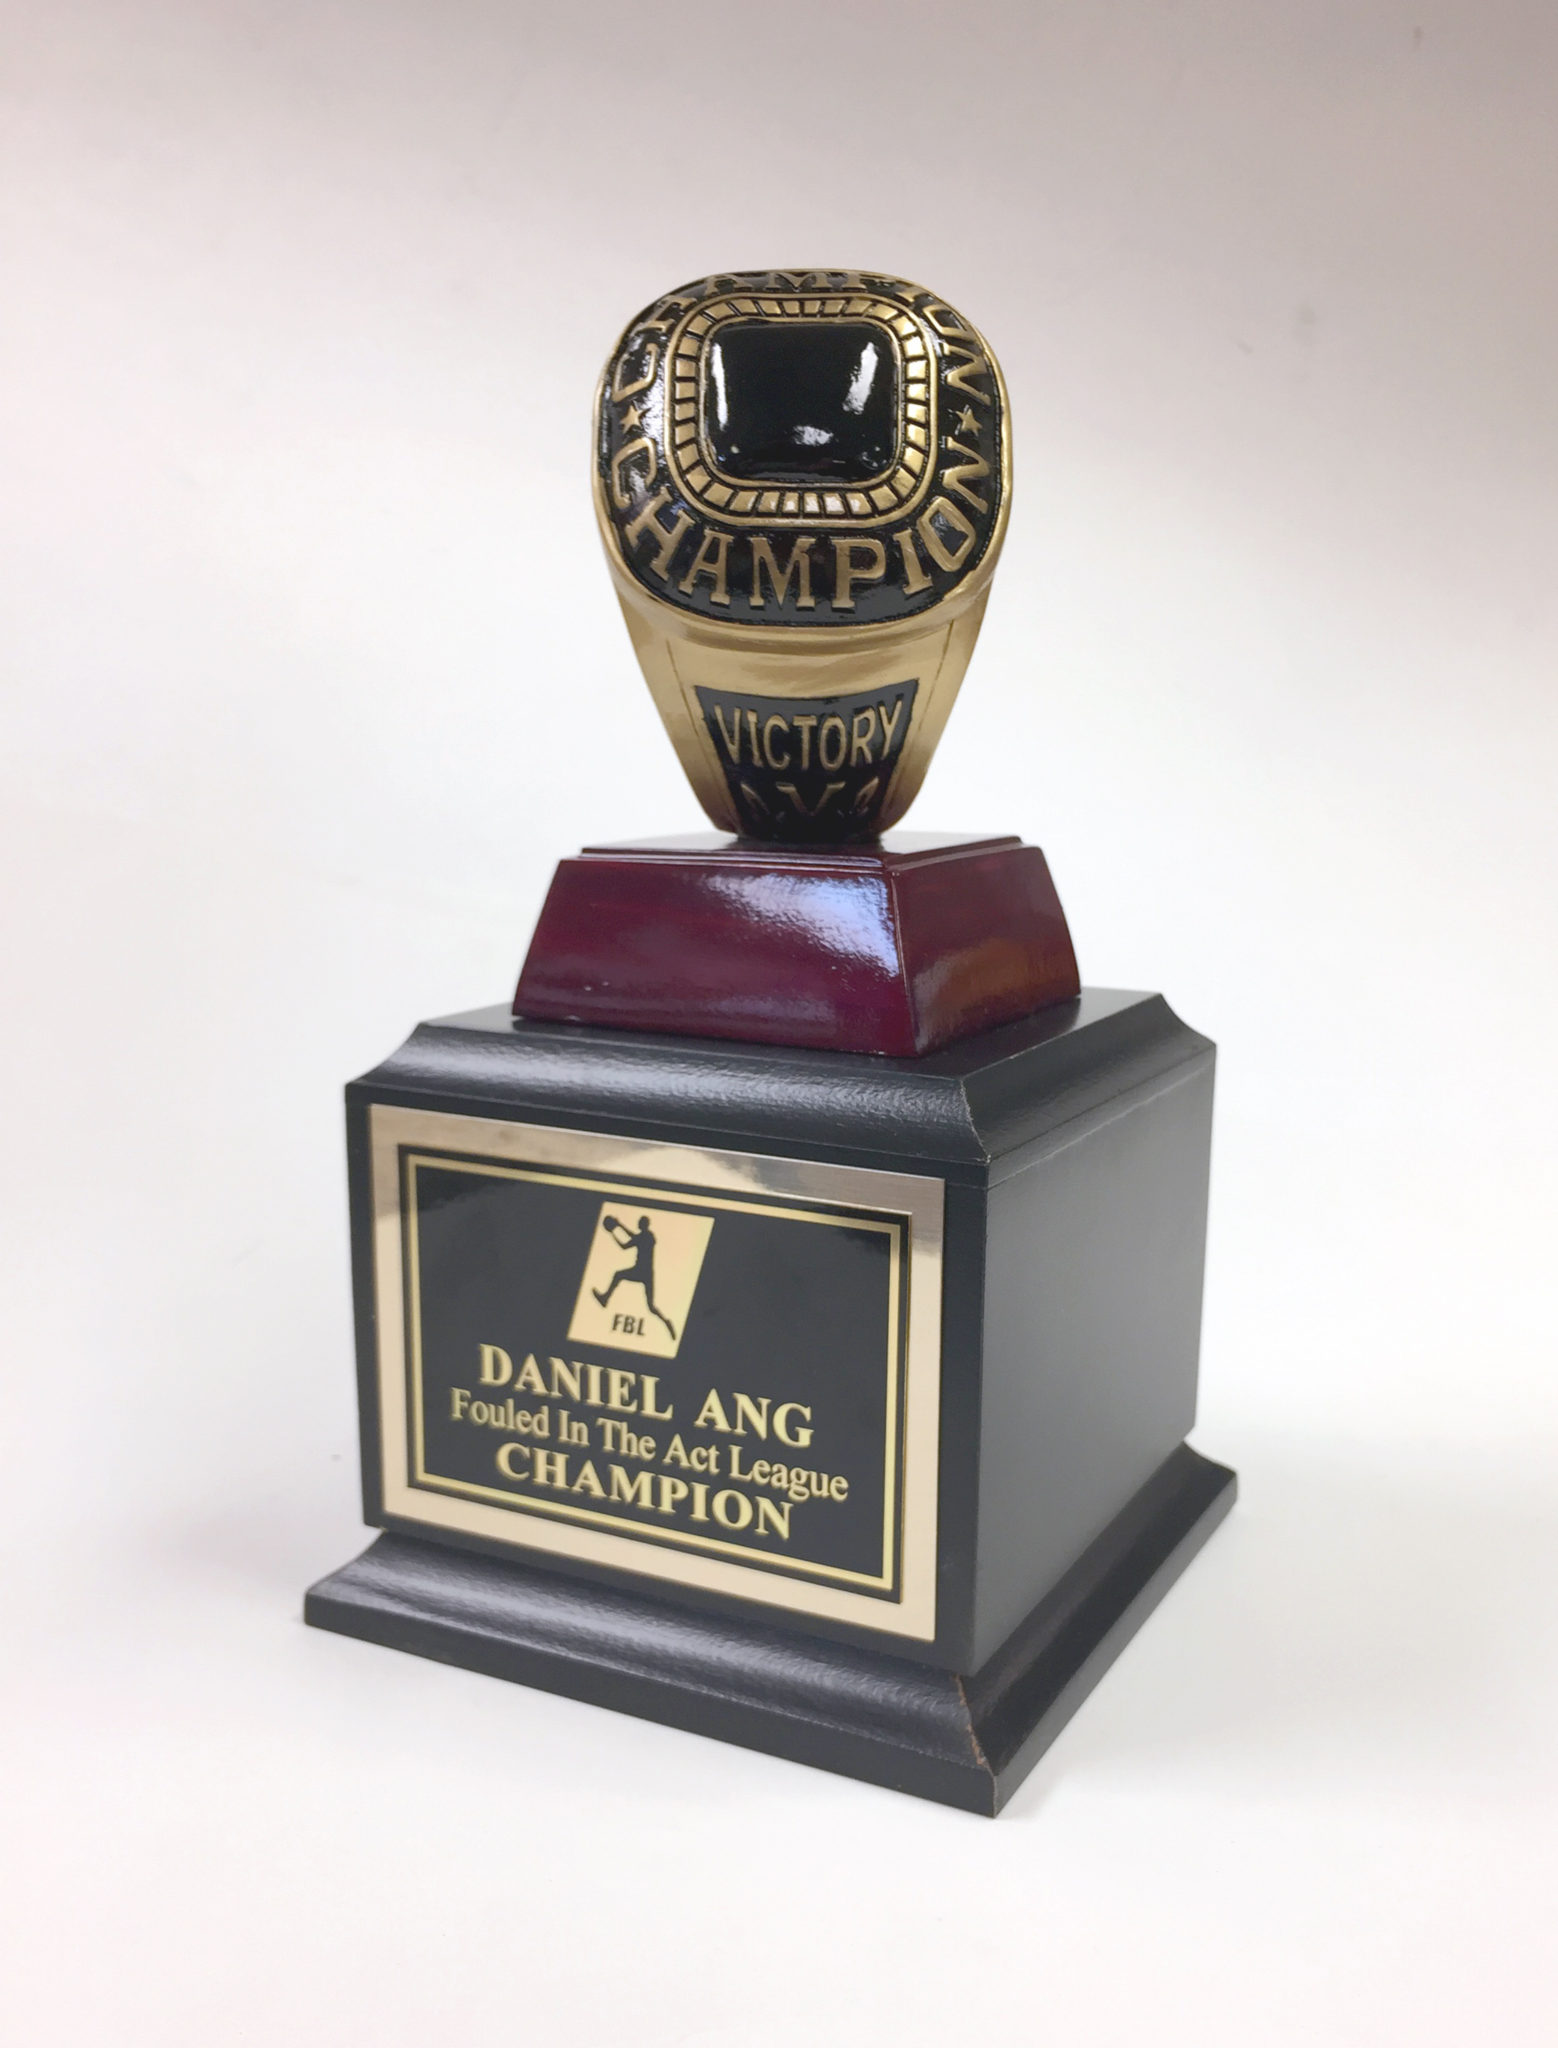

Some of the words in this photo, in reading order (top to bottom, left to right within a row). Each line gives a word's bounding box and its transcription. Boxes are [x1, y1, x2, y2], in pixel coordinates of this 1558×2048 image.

[611, 436, 991, 614] CHAMPION
[713, 700, 903, 771] VICTORY
[611, 1312, 647, 1337] FBL
[449, 1387, 551, 1439] Fouled
[557, 1409, 590, 1447] In
[597, 1417, 657, 1461] The
[661, 1433, 720, 1476] Act
[728, 1445, 850, 1502] League
[478, 1343, 674, 1422] DANIEL
[694, 1388, 815, 1448] ANG
[496, 1442, 795, 1540] CHAMPION
